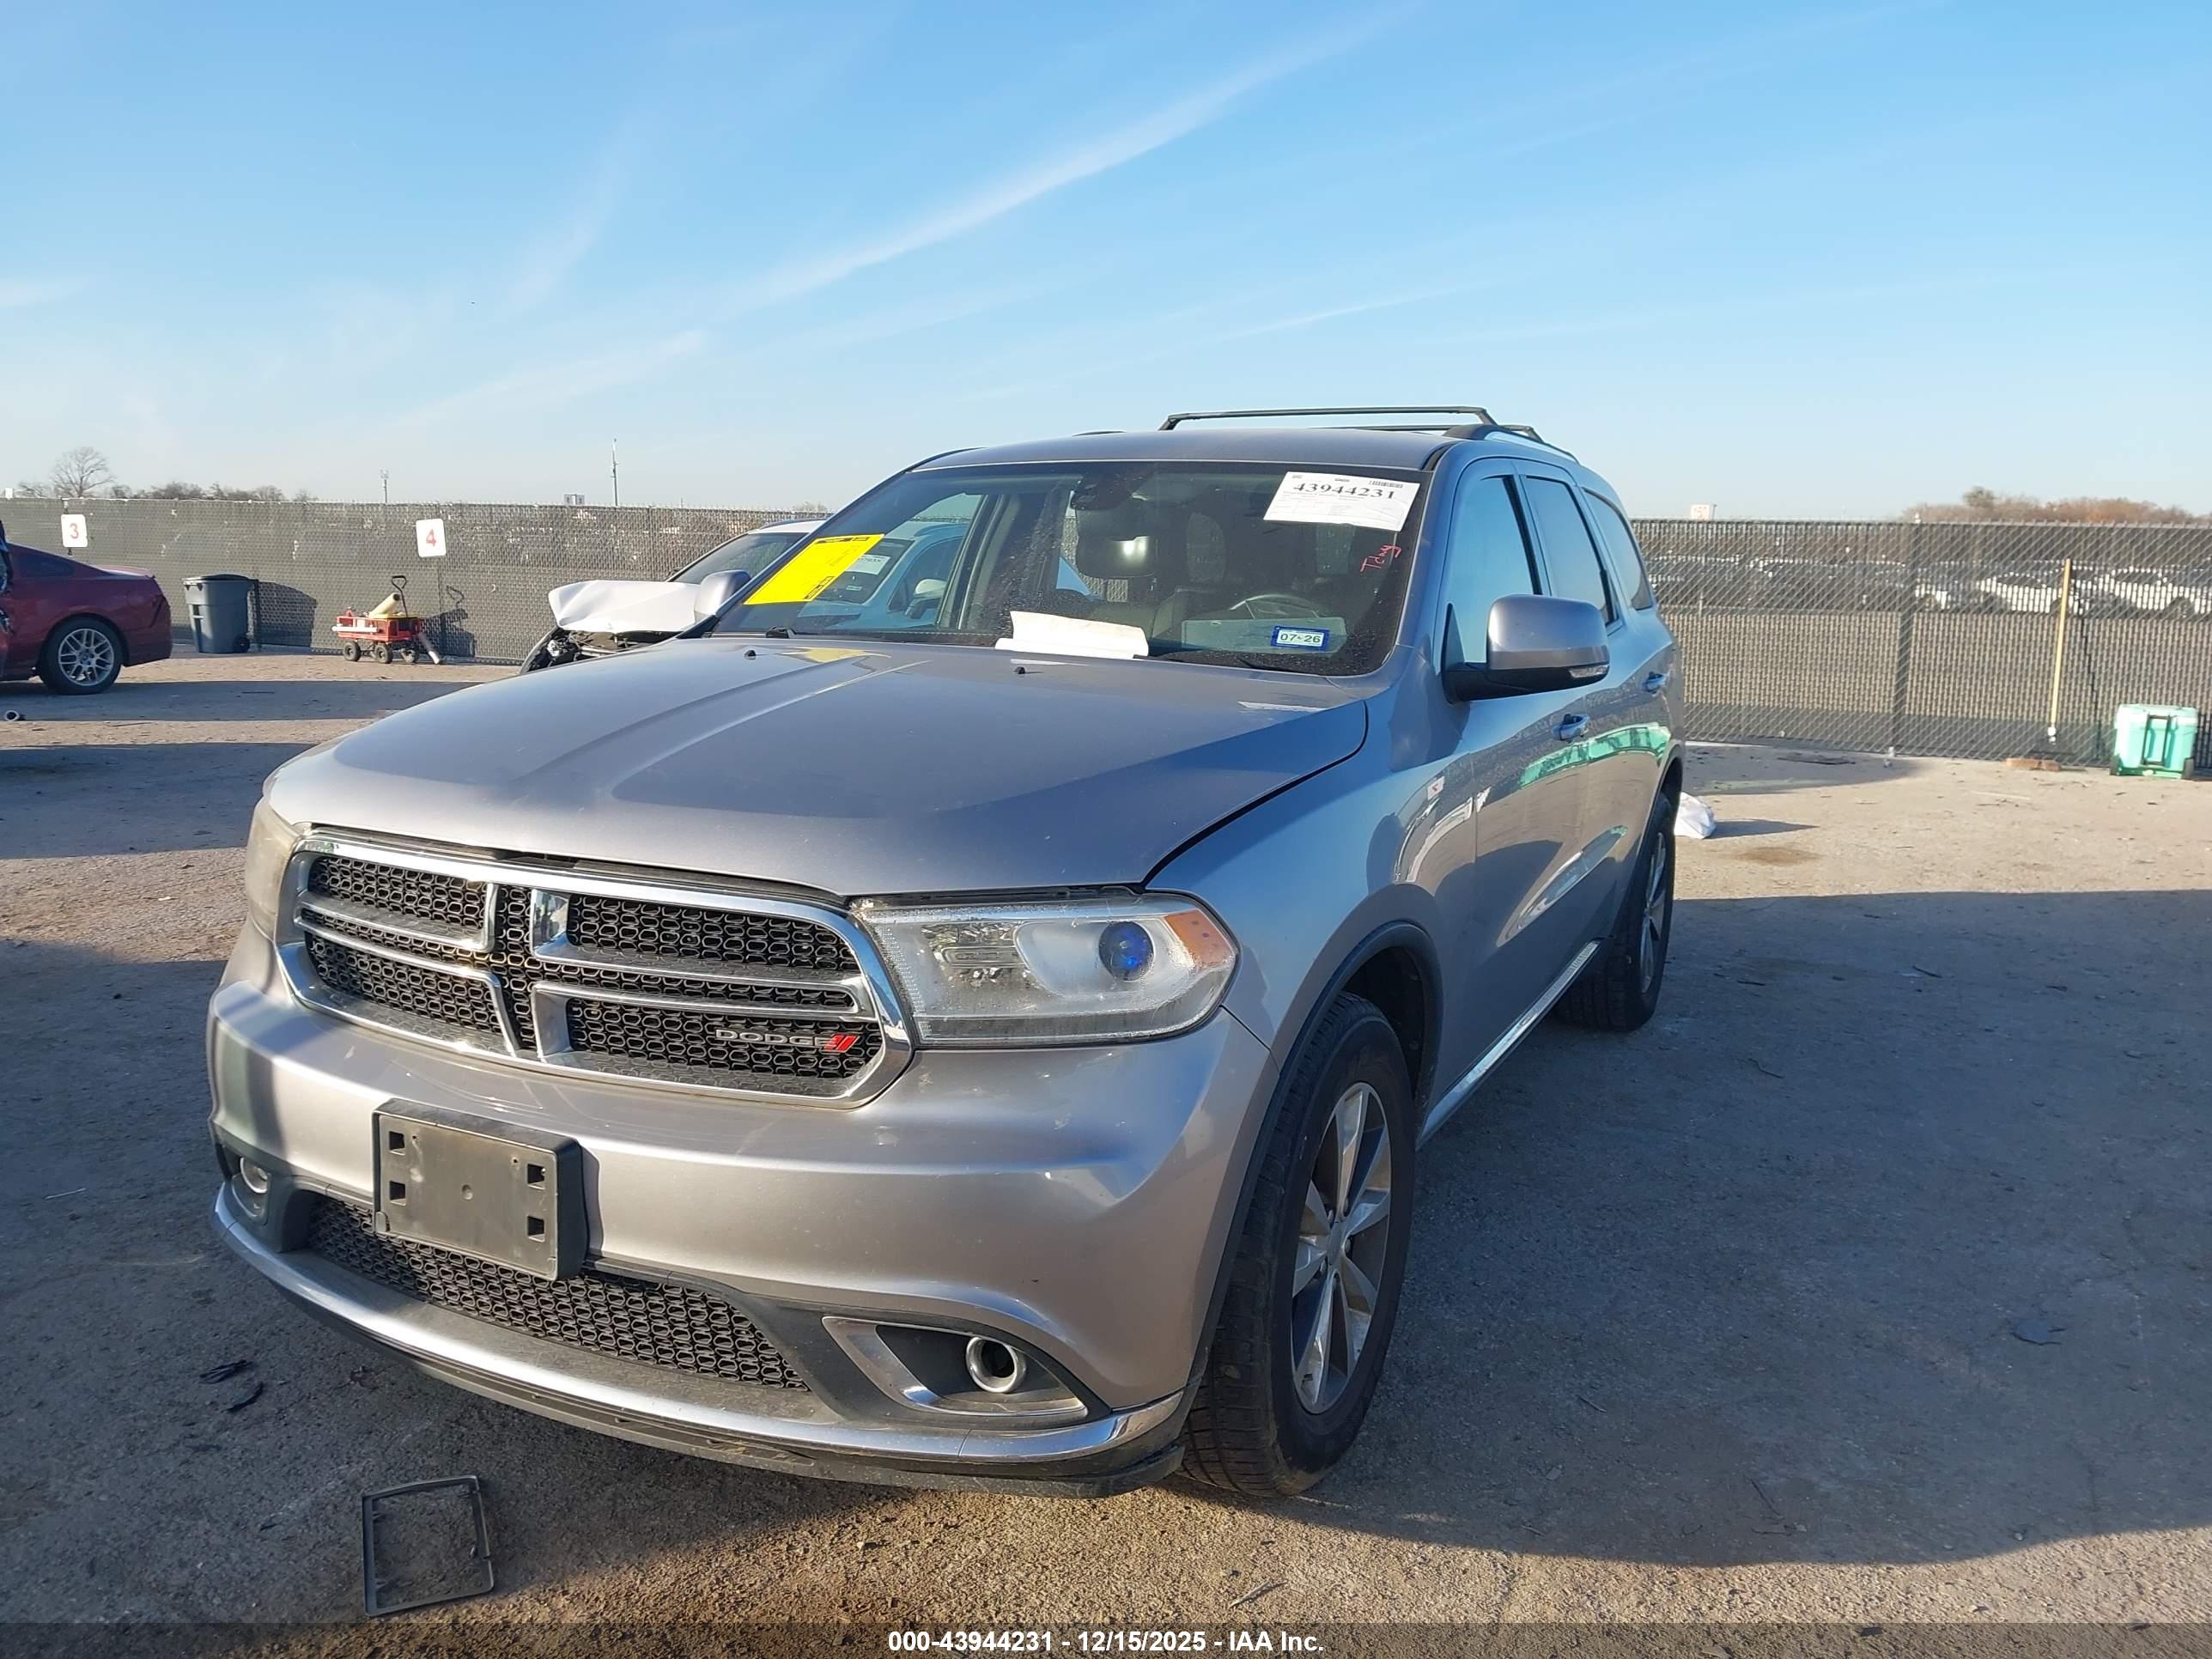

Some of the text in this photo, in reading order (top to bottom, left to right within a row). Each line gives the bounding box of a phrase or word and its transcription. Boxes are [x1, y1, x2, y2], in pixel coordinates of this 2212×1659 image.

[1293, 482, 1396, 500] 43944231
[69, 522, 80, 539] 3
[425, 528, 437, 547] 4
[714, 1028, 835, 1049] DODGE
